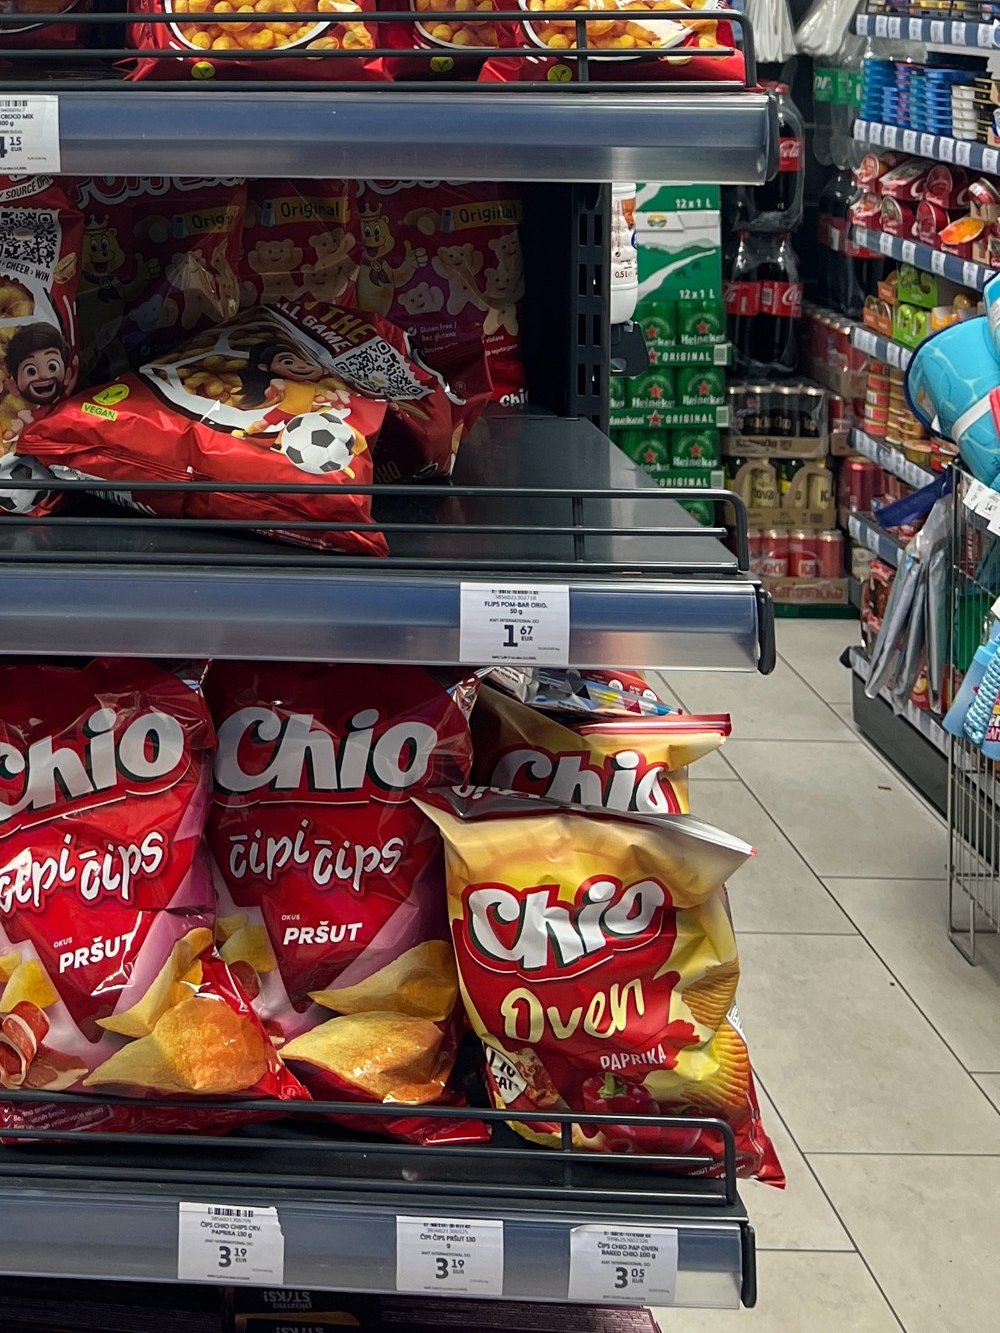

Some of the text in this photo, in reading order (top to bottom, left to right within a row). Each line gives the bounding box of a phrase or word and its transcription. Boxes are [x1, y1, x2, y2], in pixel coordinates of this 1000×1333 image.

[9, 136, 22, 146] 15
[5, 183, 37, 200] SOURCE
[279, 200, 340, 220] Original
[675, 198, 686, 209] 12
[458, 205, 518, 224] Original
[5, 261, 30, 276] CHEER
[35, 270, 50, 282] WIN
[679, 289, 690, 299] 12
[302, 314, 353, 354] GAME
[662, 351, 712, 362] ORIGINAL
[81, 402, 118, 422] VEGAN
[665, 414, 714, 424] ORIGINAL
[660, 477, 709, 487] ORIGINAL
[503, 624, 533, 647] 1 67
[215, 706, 439, 792] Chio
[281, 913, 301, 922] OKUS
[468, 880, 665, 969] Chio
[53, 936, 73, 949] OKUS
[283, 919, 362, 946] PRŠUT
[59, 932, 138, 974] PRŠUT
[501, 978, 646, 1044] Oven
[600, 1043, 668, 1071] PAPRIKA
[218, 1246, 247, 1268] 3 19
[435, 1258, 465, 1279] 3 19
[614, 1267, 645, 1288] 3 05
